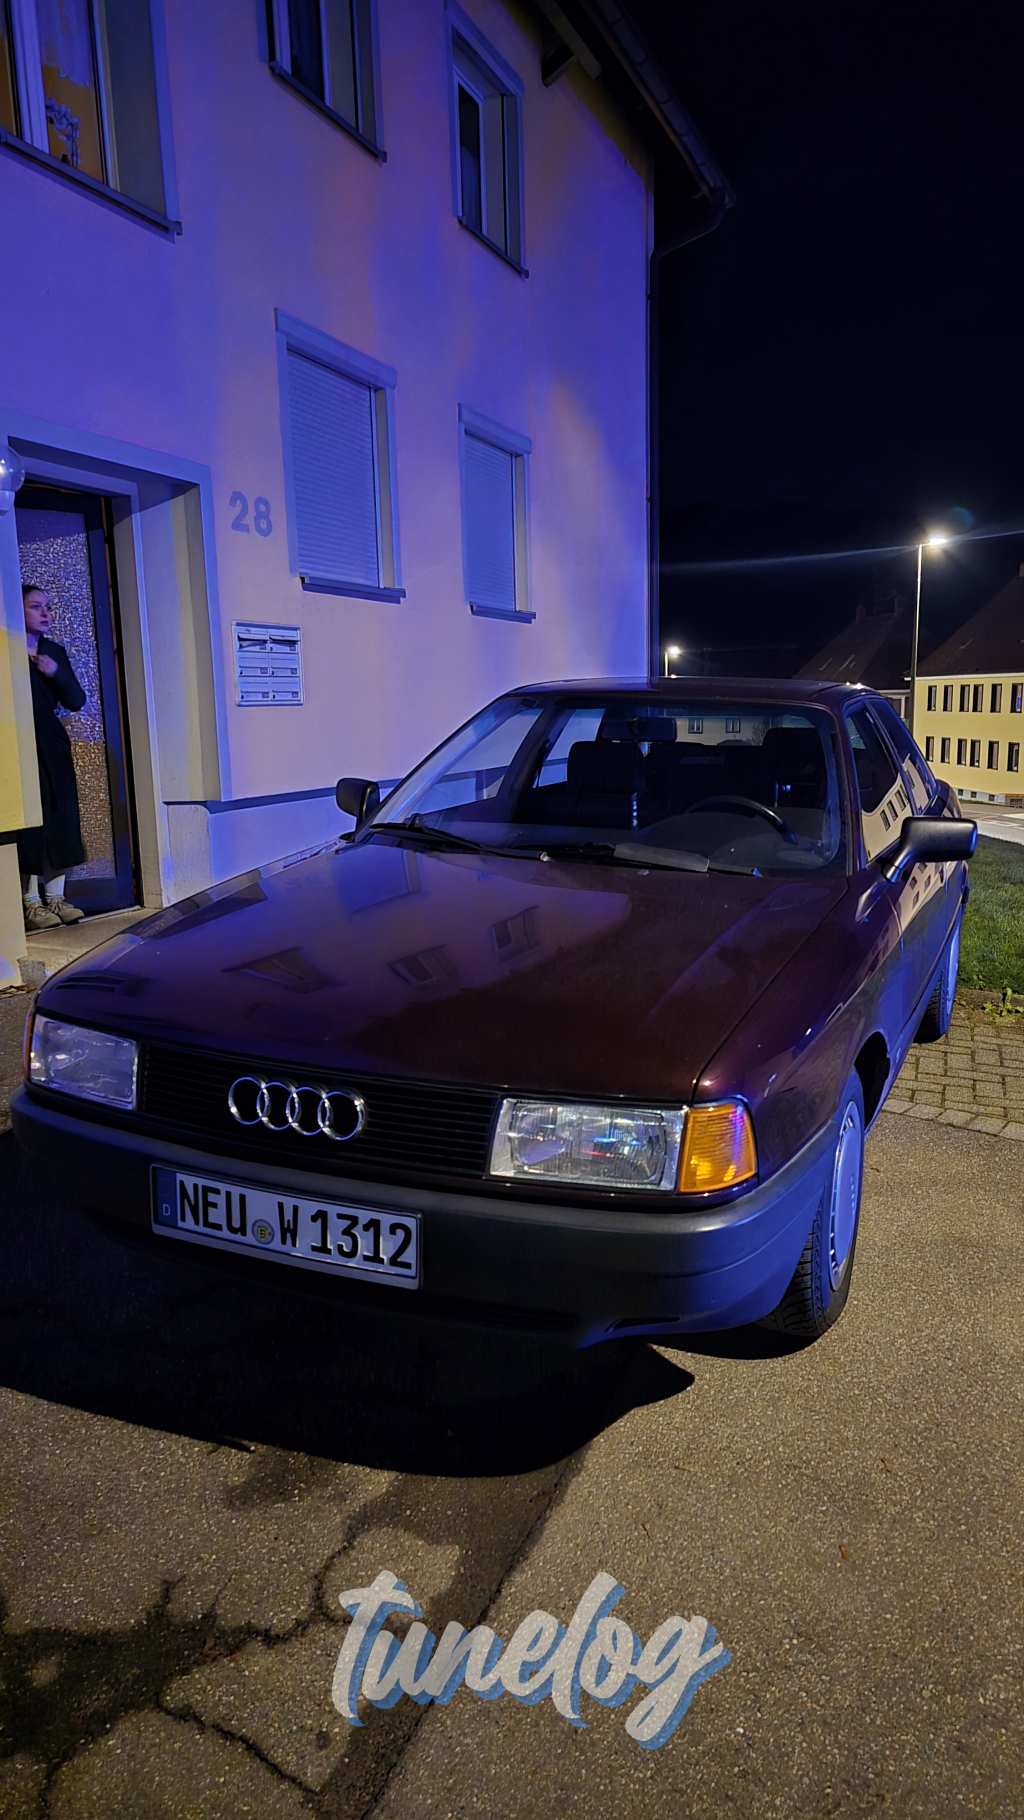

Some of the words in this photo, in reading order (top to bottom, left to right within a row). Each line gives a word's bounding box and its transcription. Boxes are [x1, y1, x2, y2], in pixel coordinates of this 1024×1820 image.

[229, 491, 273, 537] 28
[162, 1203, 171, 1216] D
[179, 1179, 247, 1237] NEU
[277, 1201, 299, 1248] W
[310, 1209, 413, 1270] 1312
